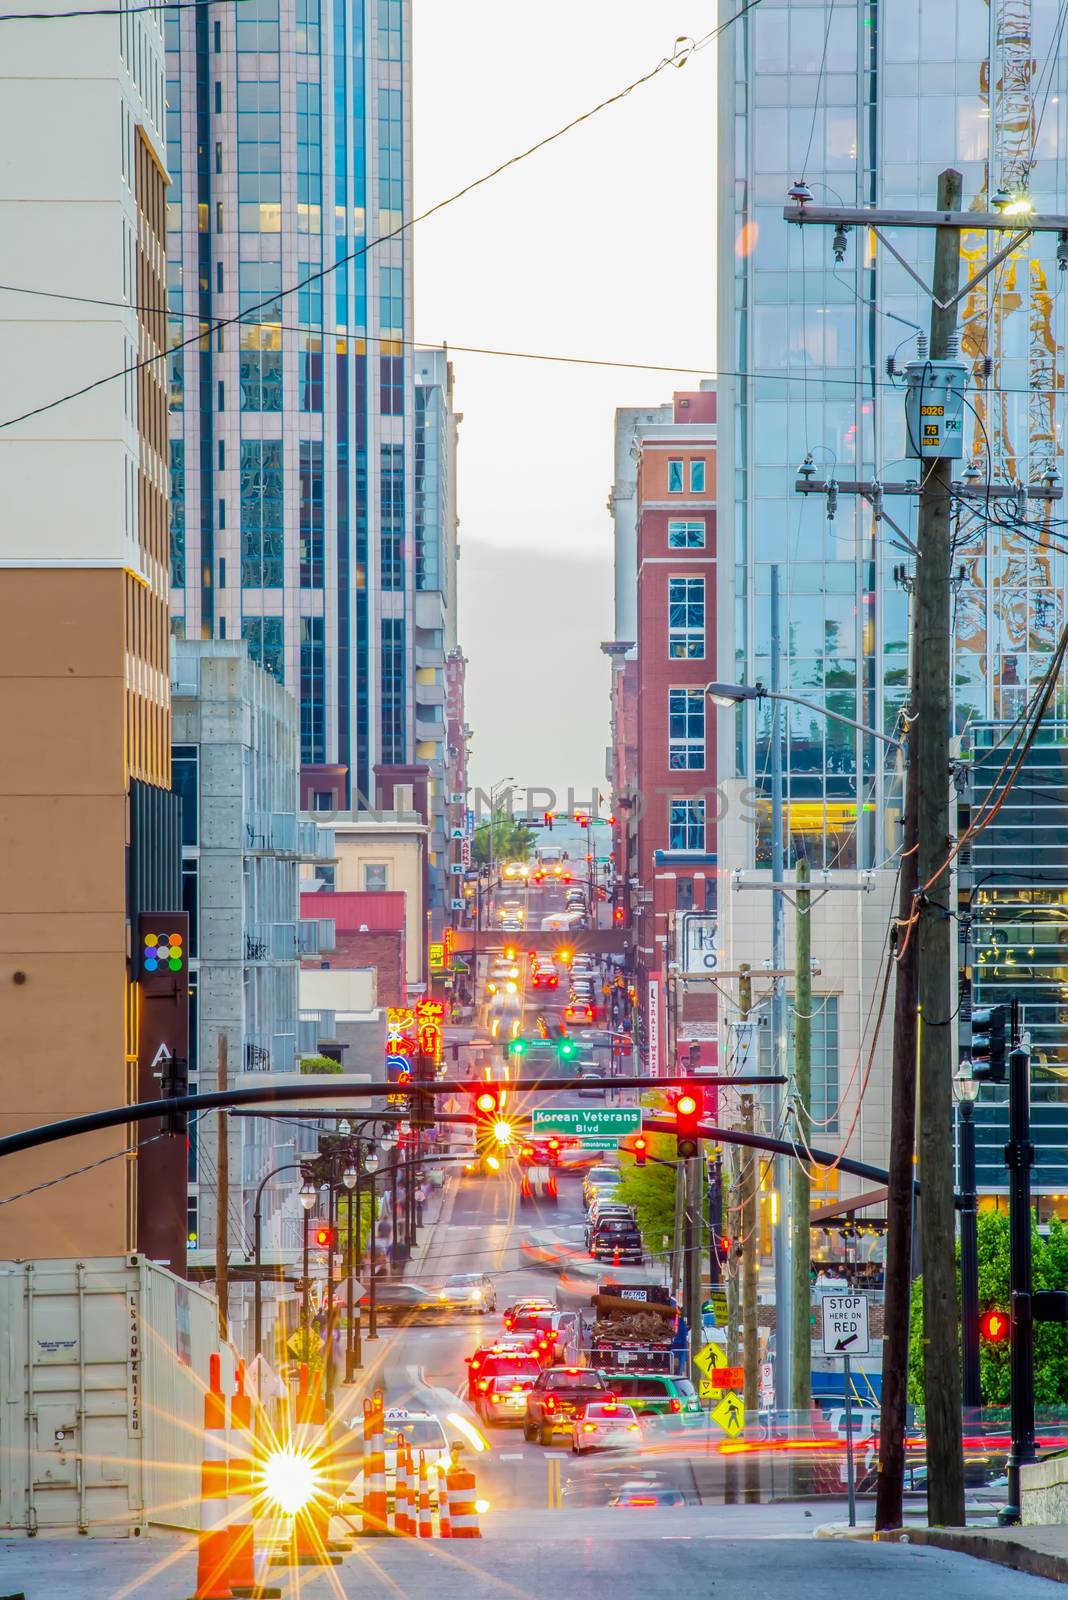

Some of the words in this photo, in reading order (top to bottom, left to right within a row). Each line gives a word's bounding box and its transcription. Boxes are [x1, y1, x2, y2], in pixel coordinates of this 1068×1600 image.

[921, 406, 943, 415] 8026
[926, 426, 937, 435] 75
[536, 1111, 579, 1122] Korean
[582, 1111, 638, 1122] Veterans
[575, 1124, 599, 1132] Blvd
[830, 1298, 860, 1309] STOP
[829, 1312, 849, 1320] HERE
[834, 1321, 858, 1332] RED
